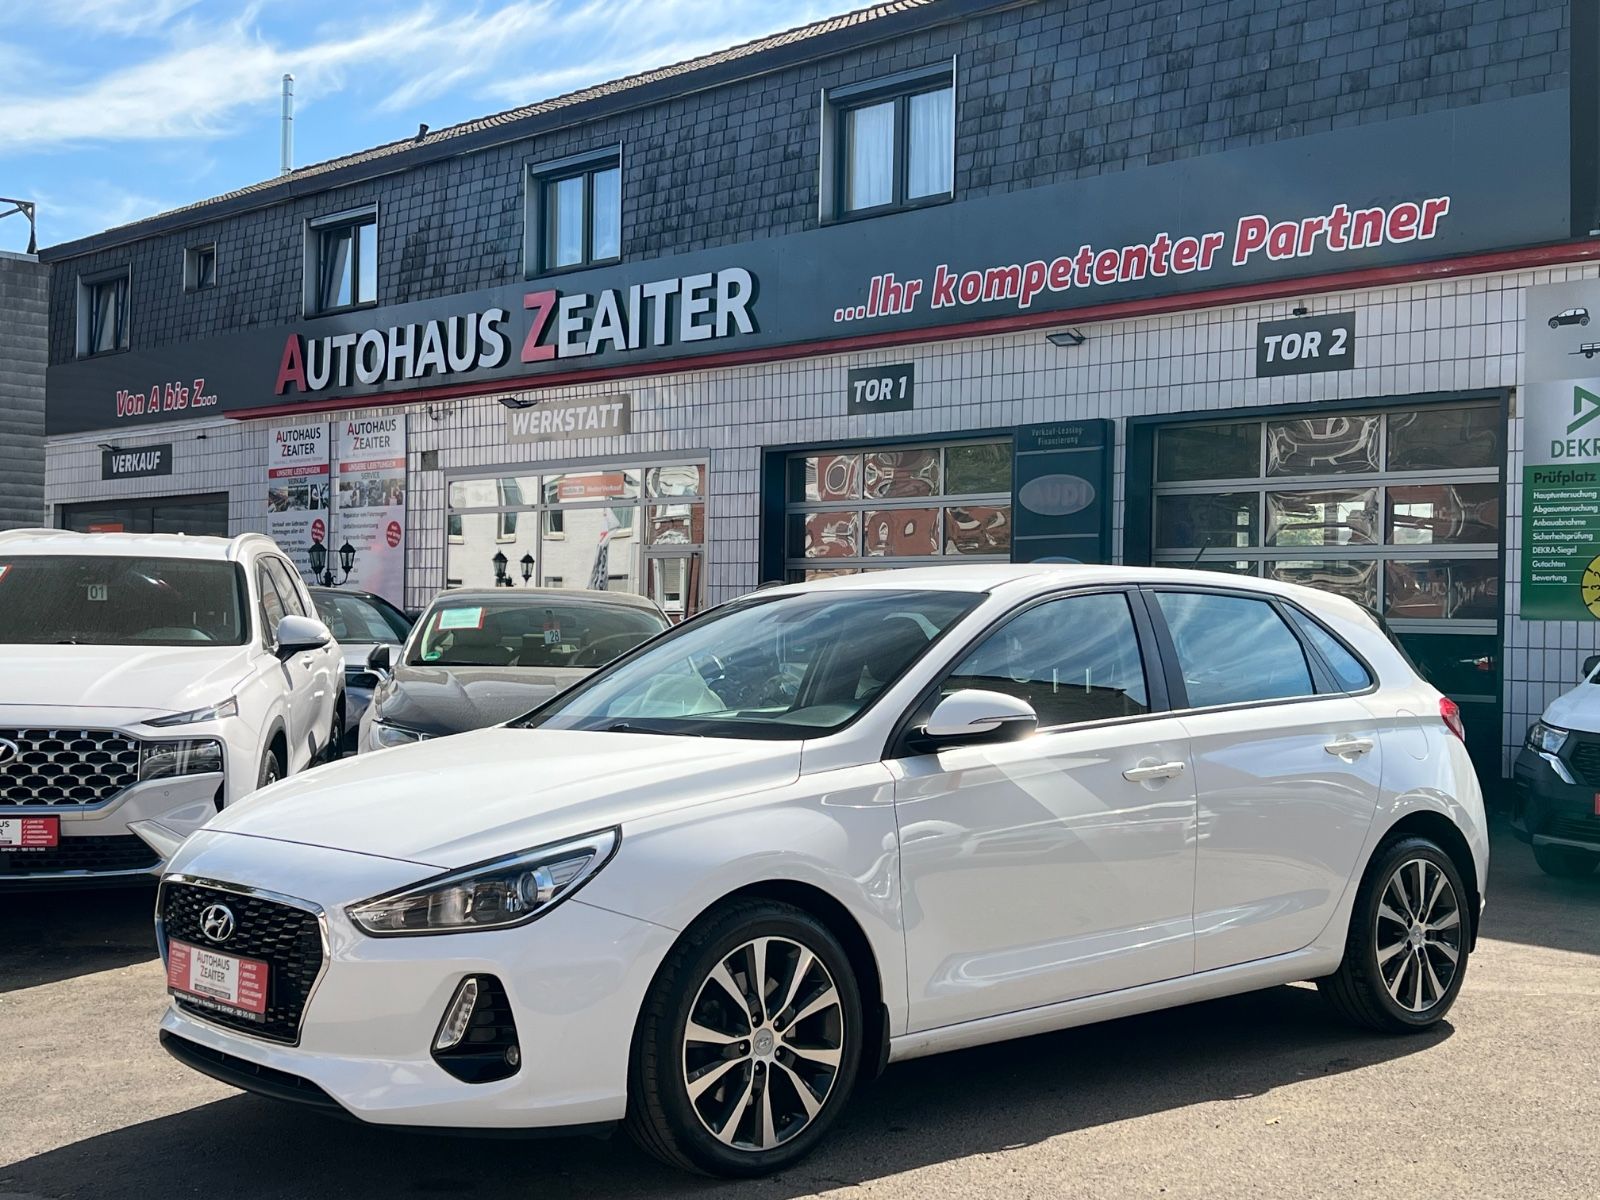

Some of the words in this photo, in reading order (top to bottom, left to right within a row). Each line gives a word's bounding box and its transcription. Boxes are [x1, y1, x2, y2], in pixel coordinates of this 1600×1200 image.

[834, 272, 922, 322] ...Ihr
[930, 231, 1225, 308] kompetenter
[1232, 196, 1451, 266] Partner
[275, 308, 505, 395] AUTOHAUS
[521, 267, 755, 363] ZEAITER
[1263, 331, 1321, 363] TOR
[1327, 328, 1348, 356] 2
[116, 390, 145, 417] Von
[147, 385, 161, 413] A
[163, 381, 189, 411] bis
[191, 378, 217, 407] Z...
[853, 378, 892, 403] TOR
[898, 376, 908, 399] 1
[347, 419, 397, 436] AUTOHAUS
[512, 403, 624, 436] WERKSTATT
[276, 427, 321, 443] AUTOHAUS
[353, 435, 391, 451] ZEAITER
[281, 443, 315, 457] ZEAITER
[112, 451, 161, 473] VERKAUF
[1533, 470, 1598, 486] Prüfplatz
[1533, 490, 1598, 501] Hauptuntersuchung
[1533, 504, 1599, 515] Abgasuntersuchung
[1533, 518, 1587, 527] Anbauabnahme
[1532, 531, 1594, 541] Sicherheitsprüfung
[1532, 546, 1578, 555] DEKRA-Siegel
[1532, 560, 1566, 568] Gutachten
[1531, 574, 1567, 583] Bewertung
[91, 586, 103, 599] 01
[550, 630, 560, 642] 28
[197, 951, 230, 971] AUTOHAUS
[200, 965, 226, 983] ZEAITER
